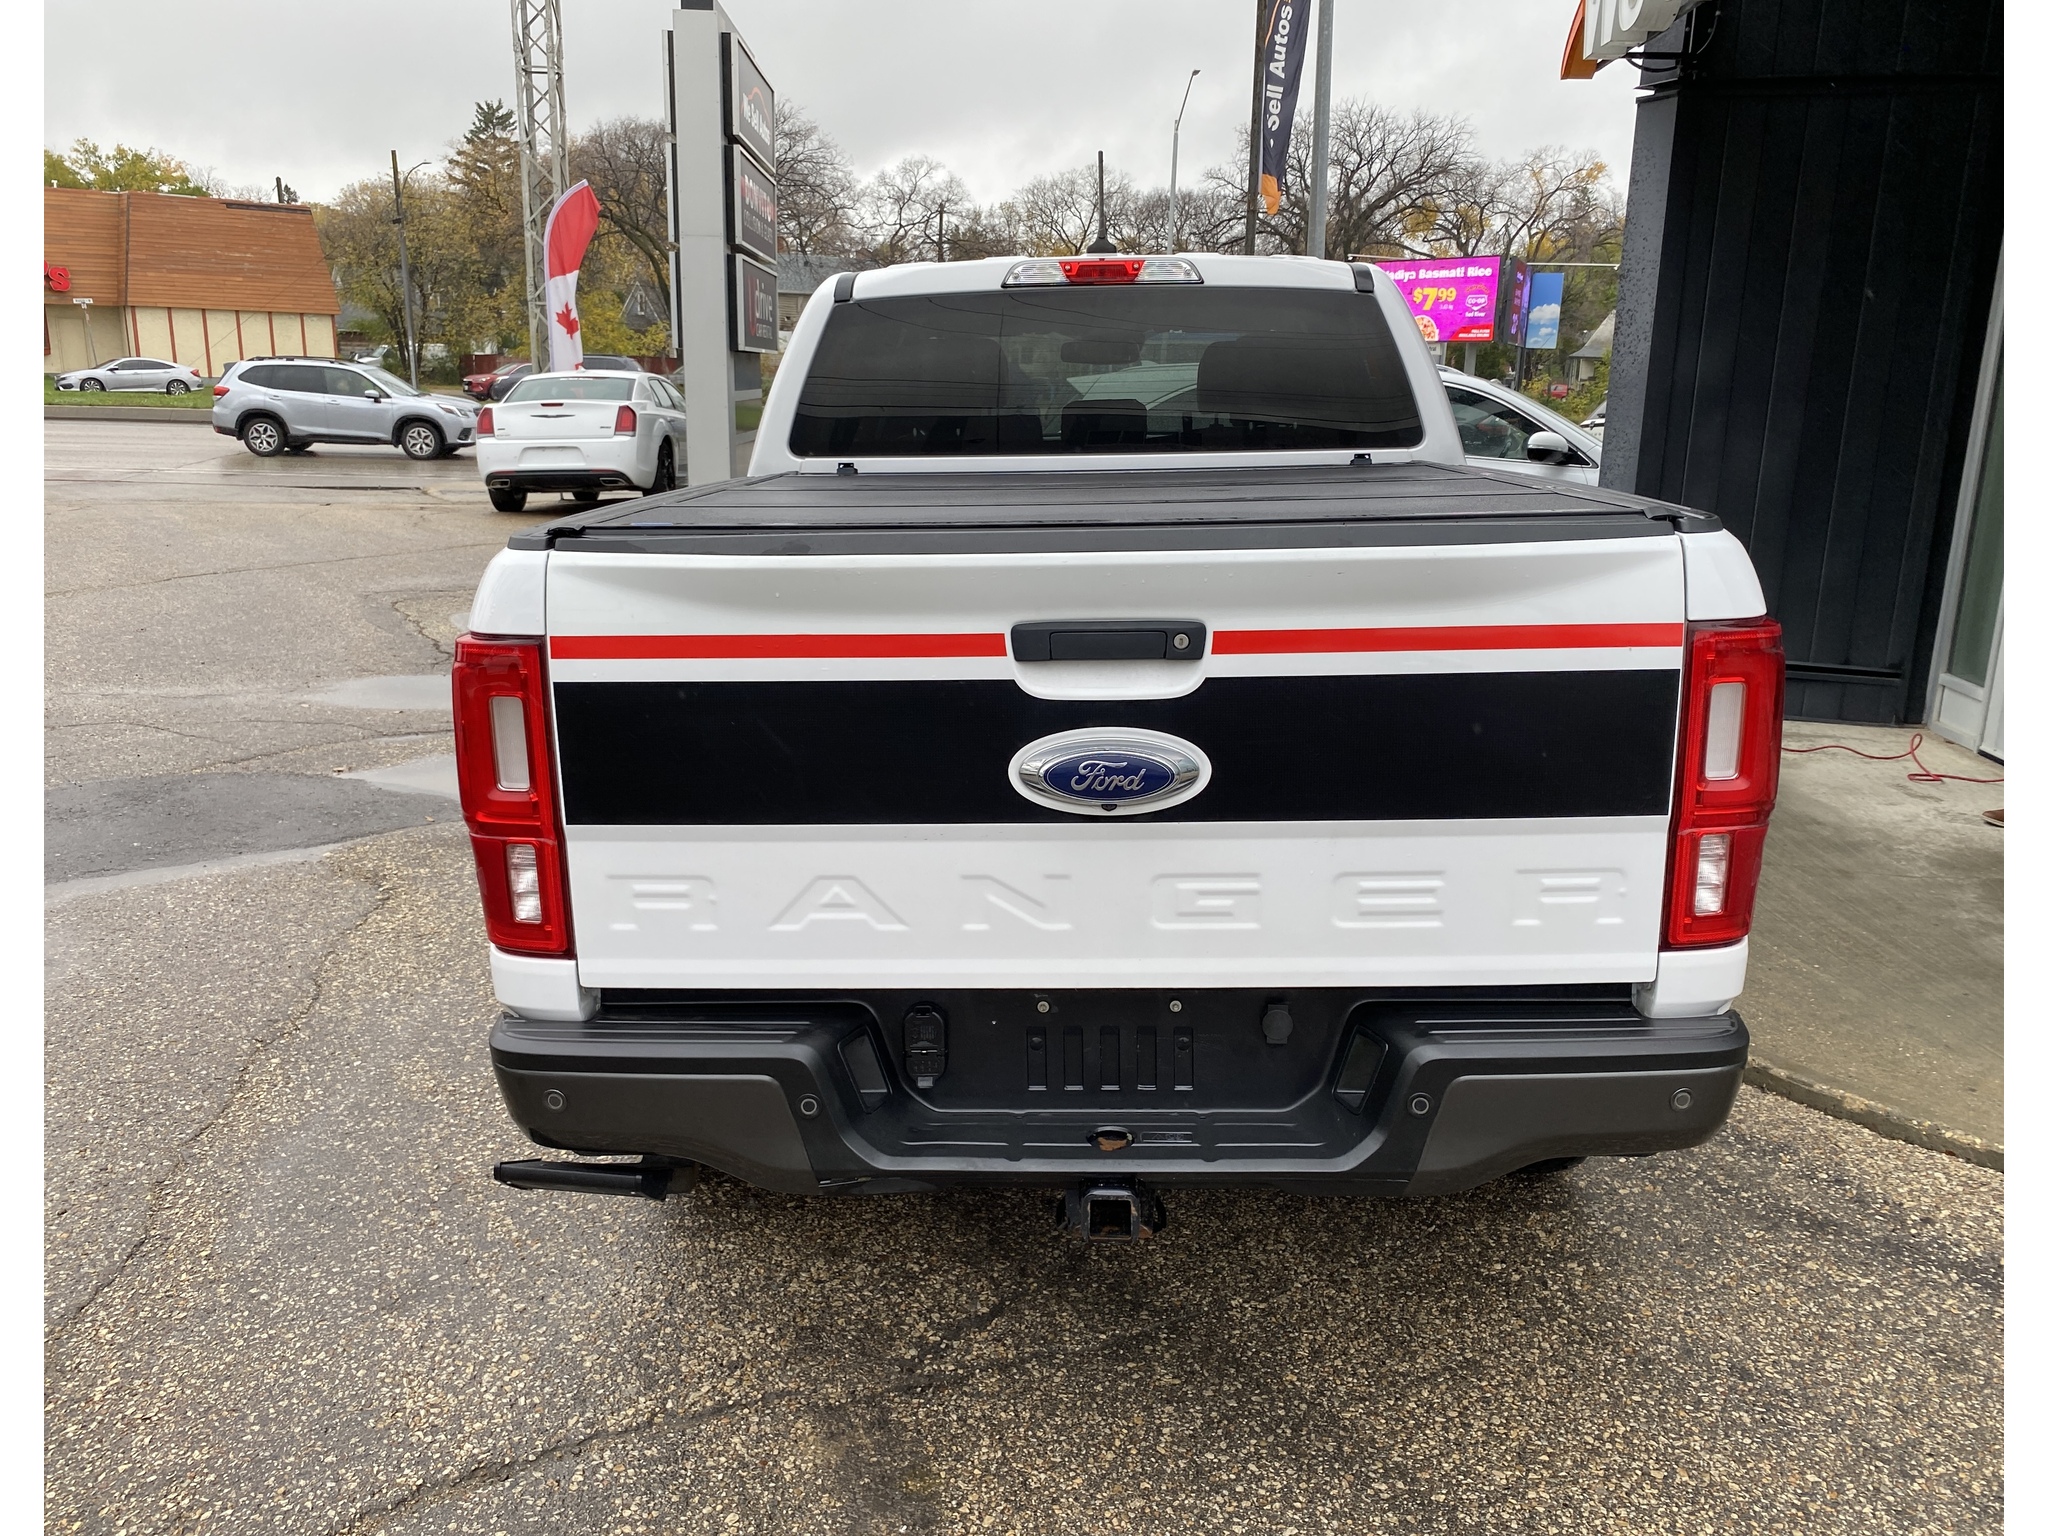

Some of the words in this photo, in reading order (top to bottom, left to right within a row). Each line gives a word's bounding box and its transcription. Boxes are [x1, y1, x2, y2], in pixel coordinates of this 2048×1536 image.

[1269, 4, 1293, 79] Autos
[1266, 84, 1284, 132] Sell
[1386, 269, 1416, 283] adiya
[1418, 266, 1465, 279] Basmati
[1467, 265, 1493, 277] Rice
[1070, 760, 1147, 791] Ford
[605, 868, 1627, 932] RANGER
